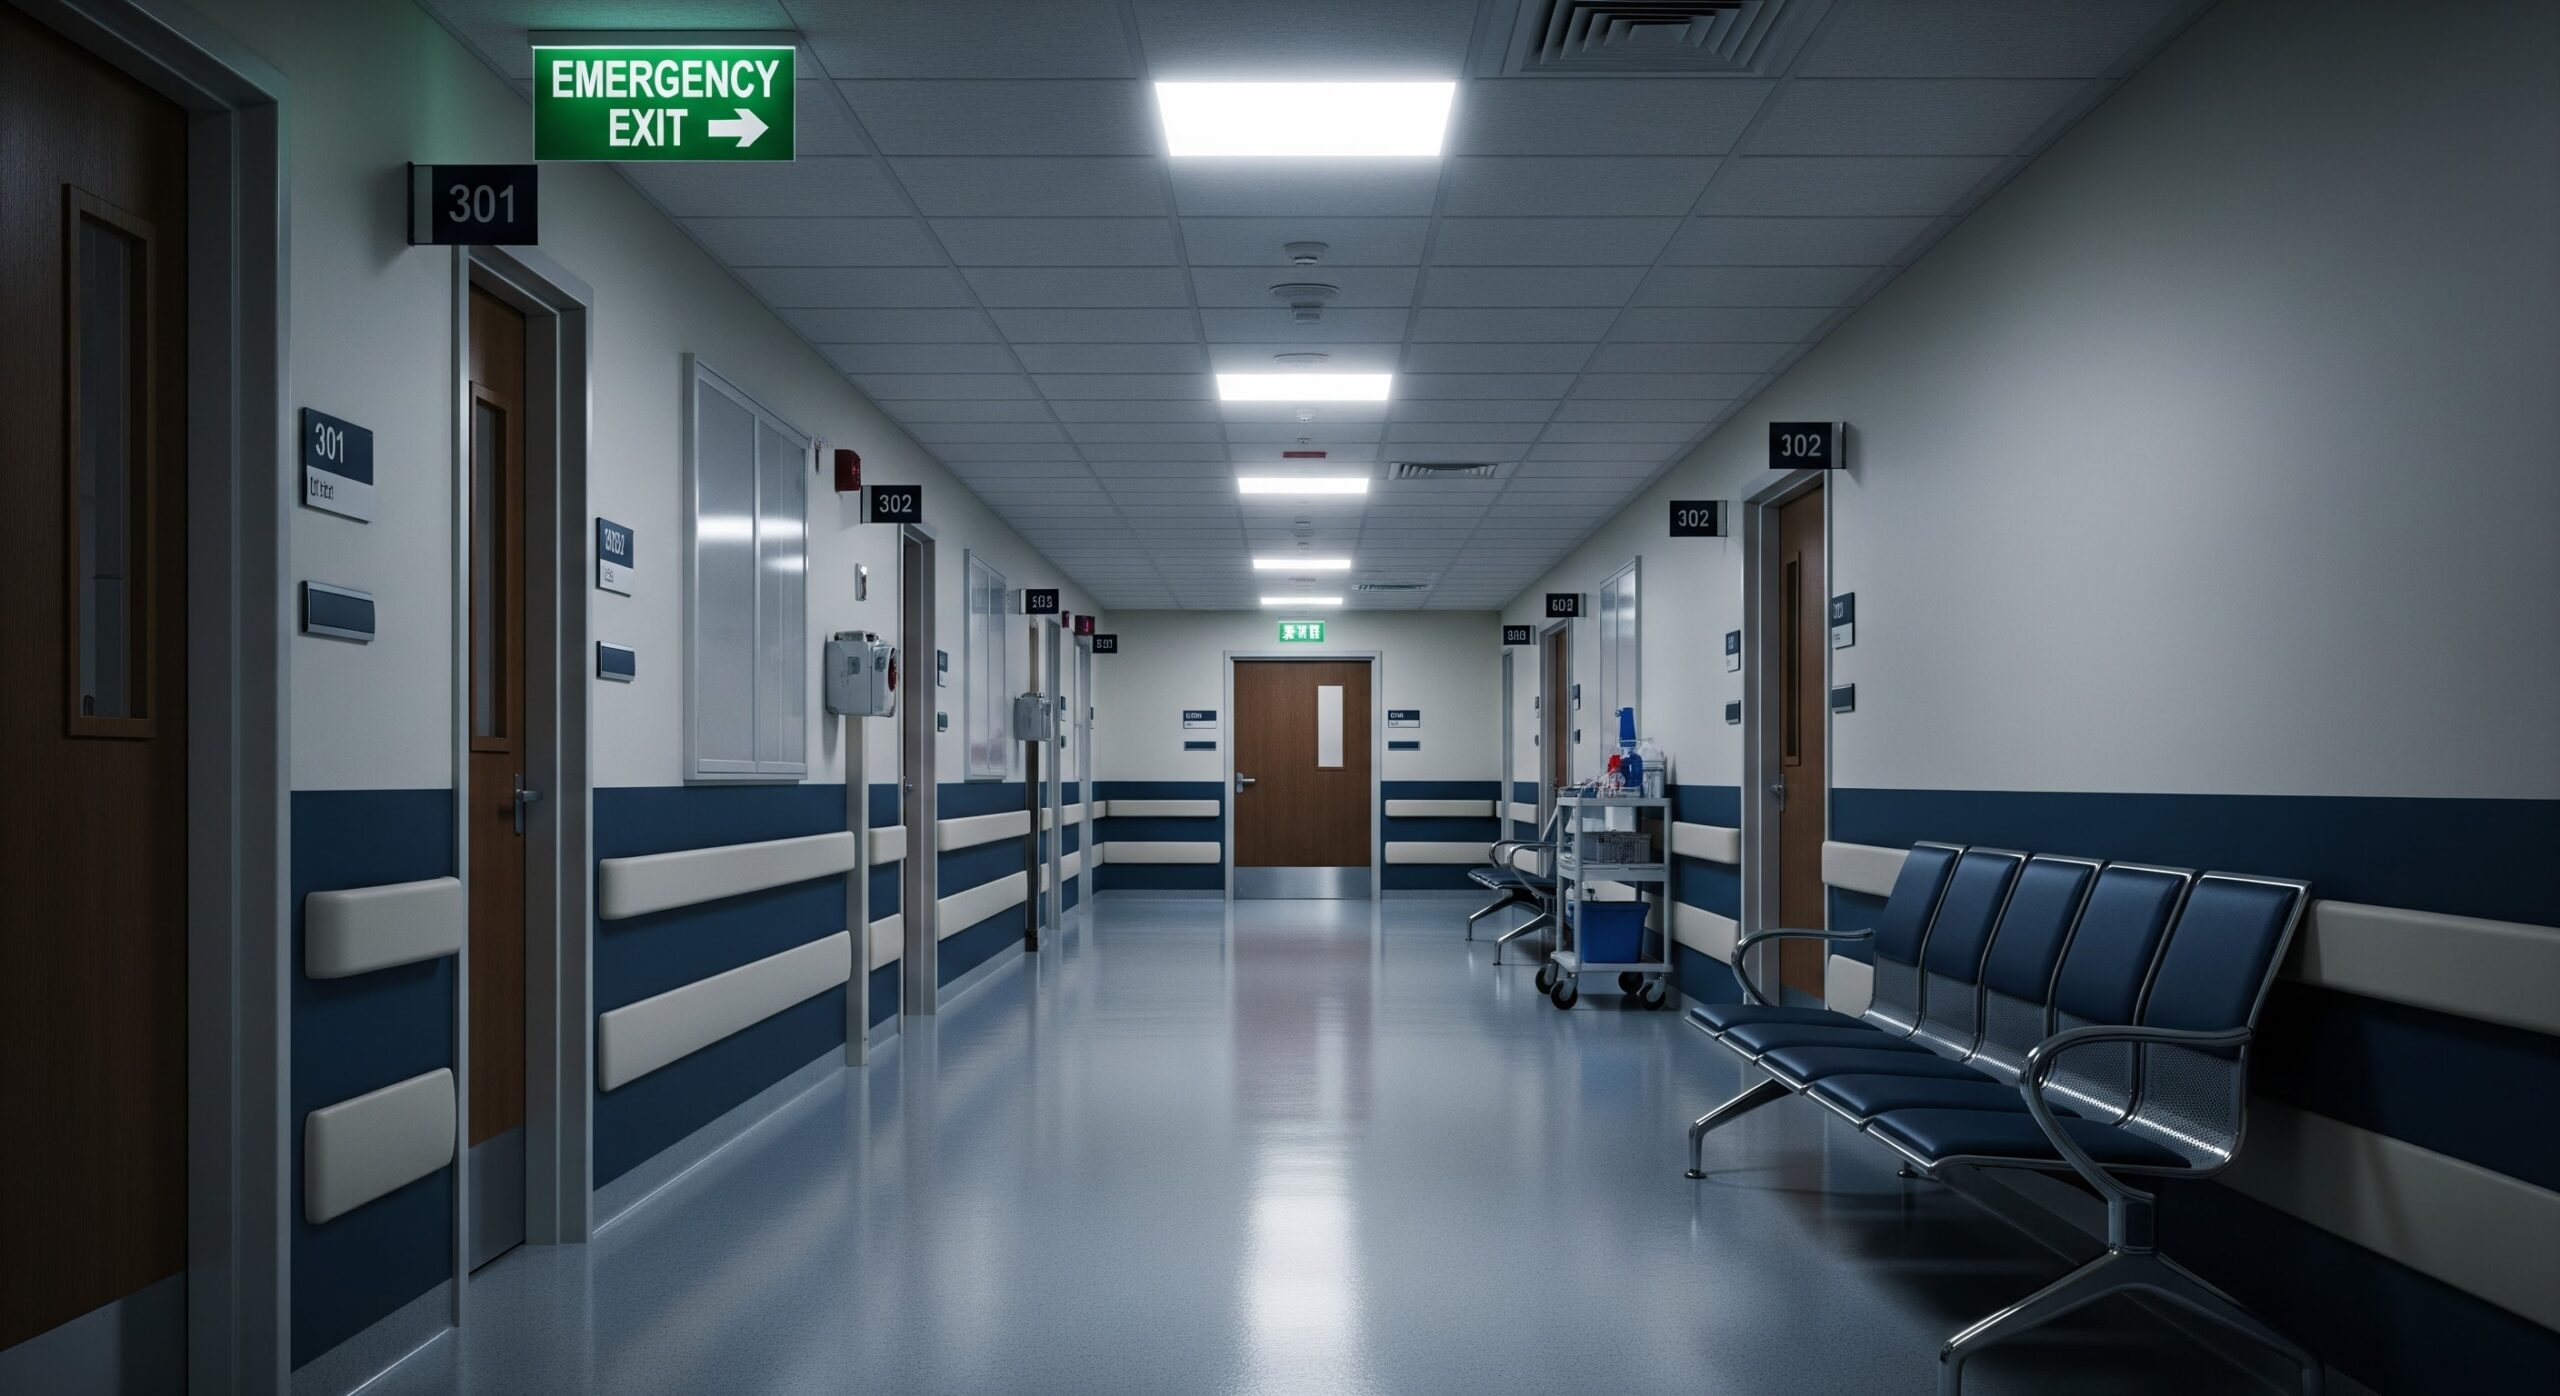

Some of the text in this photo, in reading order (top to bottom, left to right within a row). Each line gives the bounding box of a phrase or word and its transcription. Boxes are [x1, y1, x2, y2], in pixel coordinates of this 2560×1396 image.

[552, 59, 780, 98] EMERGENCY
[609, 108, 688, 146] EXIT
[449, 184, 514, 223] 301
[315, 422, 344, 464] 301
[1781, 434, 1821, 457] 302
[880, 494, 912, 513] 302
[1678, 509, 1709, 527] 302
